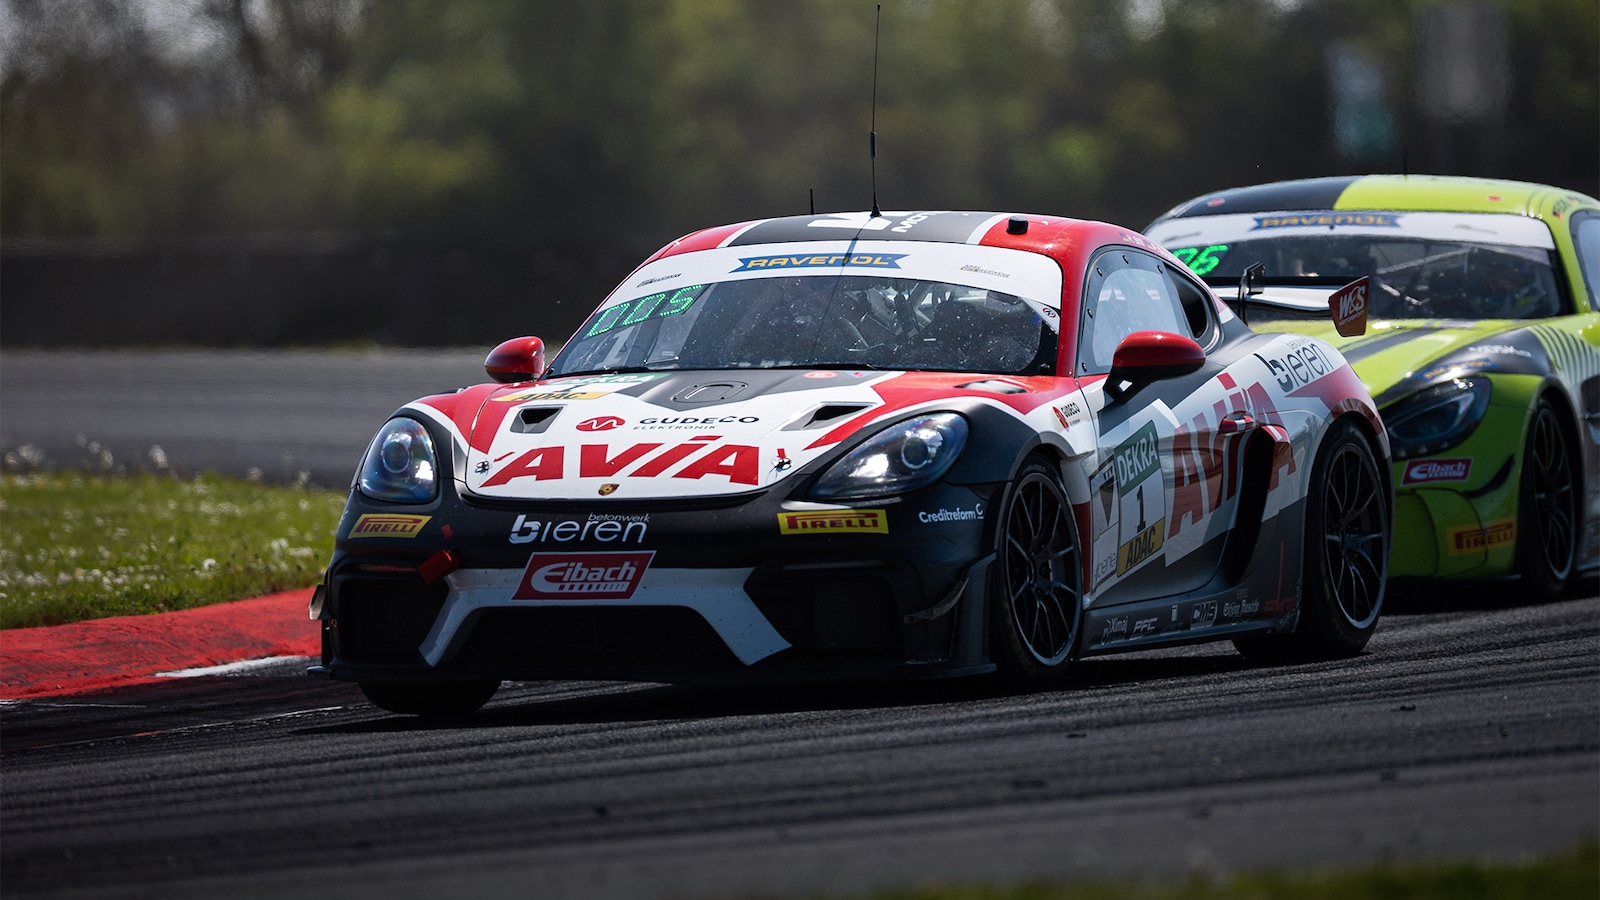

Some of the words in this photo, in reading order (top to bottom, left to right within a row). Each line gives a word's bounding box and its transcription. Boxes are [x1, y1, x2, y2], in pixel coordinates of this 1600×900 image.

[1261, 217, 1390, 228] RAVENOL
[747, 257, 889, 269] RAVENOL
[1339, 285, 1366, 319] W&S
[1253, 343, 1335, 393] bieren
[639, 415, 761, 425] GUDECO
[479, 435, 760, 488] AVIA
[1117, 430, 1159, 487] DEKRA
[1409, 460, 1467, 479] Eibach
[588, 512, 650, 523] betonwerk
[918, 507, 977, 523] Creditreform
[1135, 484, 1147, 533] 1
[355, 516, 424, 534] PIRELLI
[508, 514, 648, 544] bieren
[786, 512, 879, 530] PIRELLI
[1454, 521, 1514, 550] PIRELLI
[1125, 527, 1156, 571] ADAC
[530, 560, 637, 592] Eibach
[1132, 616, 1159, 633] PFC
